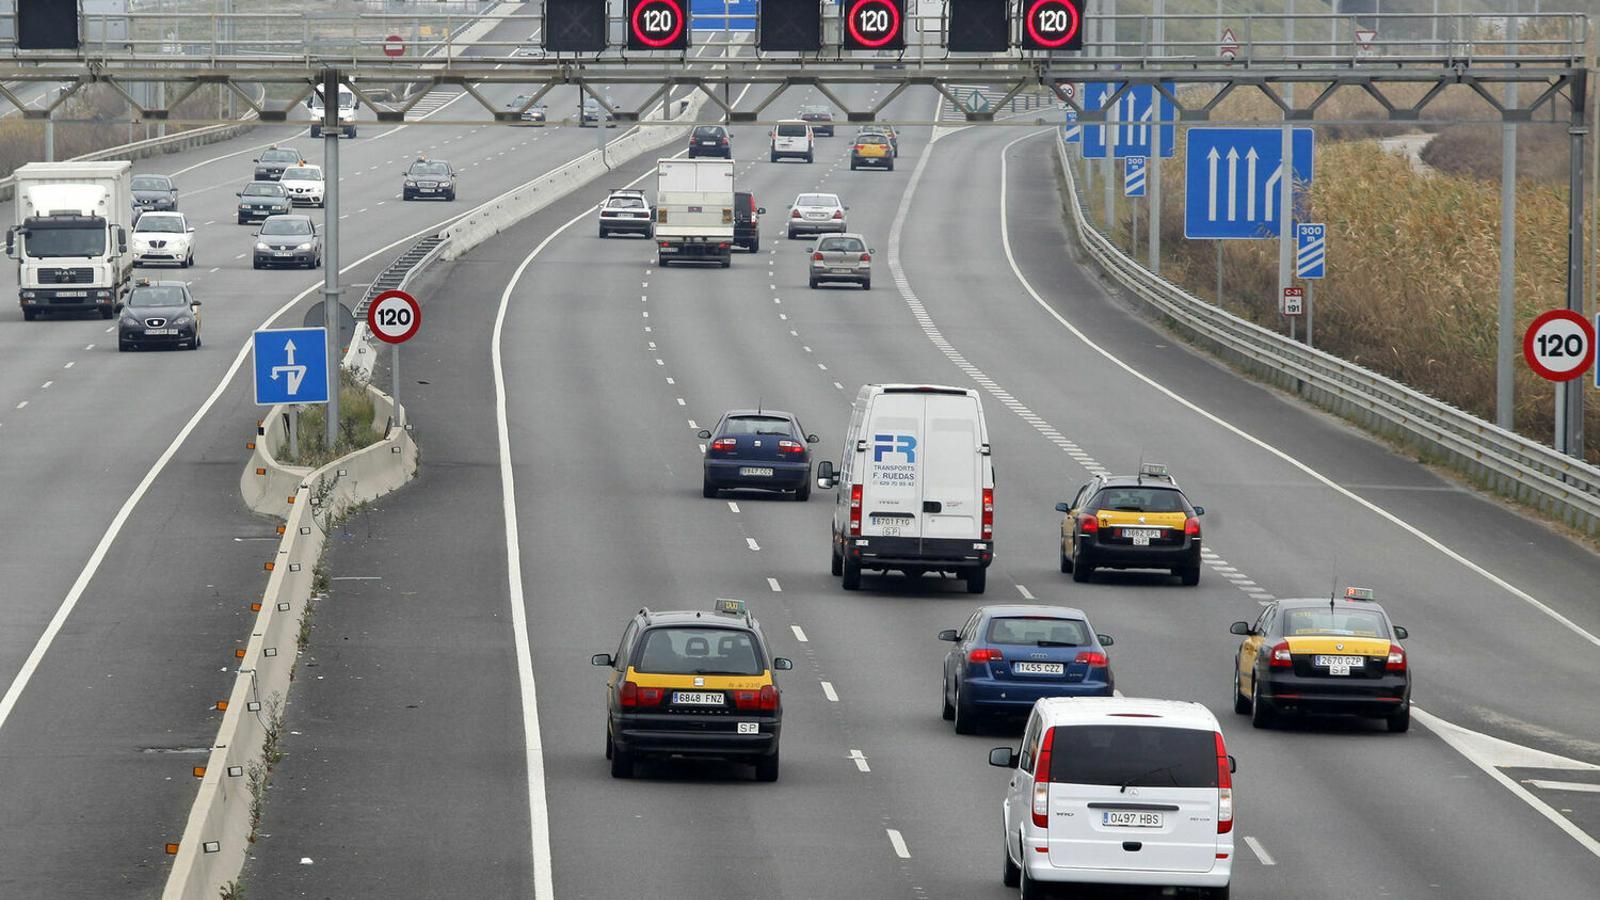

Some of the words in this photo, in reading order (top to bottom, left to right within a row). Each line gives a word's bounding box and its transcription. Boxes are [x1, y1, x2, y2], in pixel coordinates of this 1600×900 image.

[643, 10, 672, 32] 120
[860, 10, 889, 32] 120
[1038, 10, 1068, 32] 120
[1300, 226, 1322, 235] 300
[1287, 304, 1300, 312] 191
[377, 308, 411, 326] 120
[1537, 333, 1583, 357] 120
[874, 434, 917, 464] FR
[873, 464, 916, 472] TRANSPORTS
[882, 472, 915, 480] RUEDAS
[1135, 537, 1148, 545] SP
[1321, 656, 1344, 666] 2670
[1345, 656, 1363, 667] GZP
[1021, 663, 1042, 672] 1455
[1044, 663, 1061, 673] CZZ
[1332, 667, 1348, 675] SP
[679, 693, 701, 703] 6848
[705, 694, 722, 704] FNZ
[739, 723, 757, 733] SP
[1110, 813, 1136, 824] 0497
[1139, 814, 1159, 825] HBS
